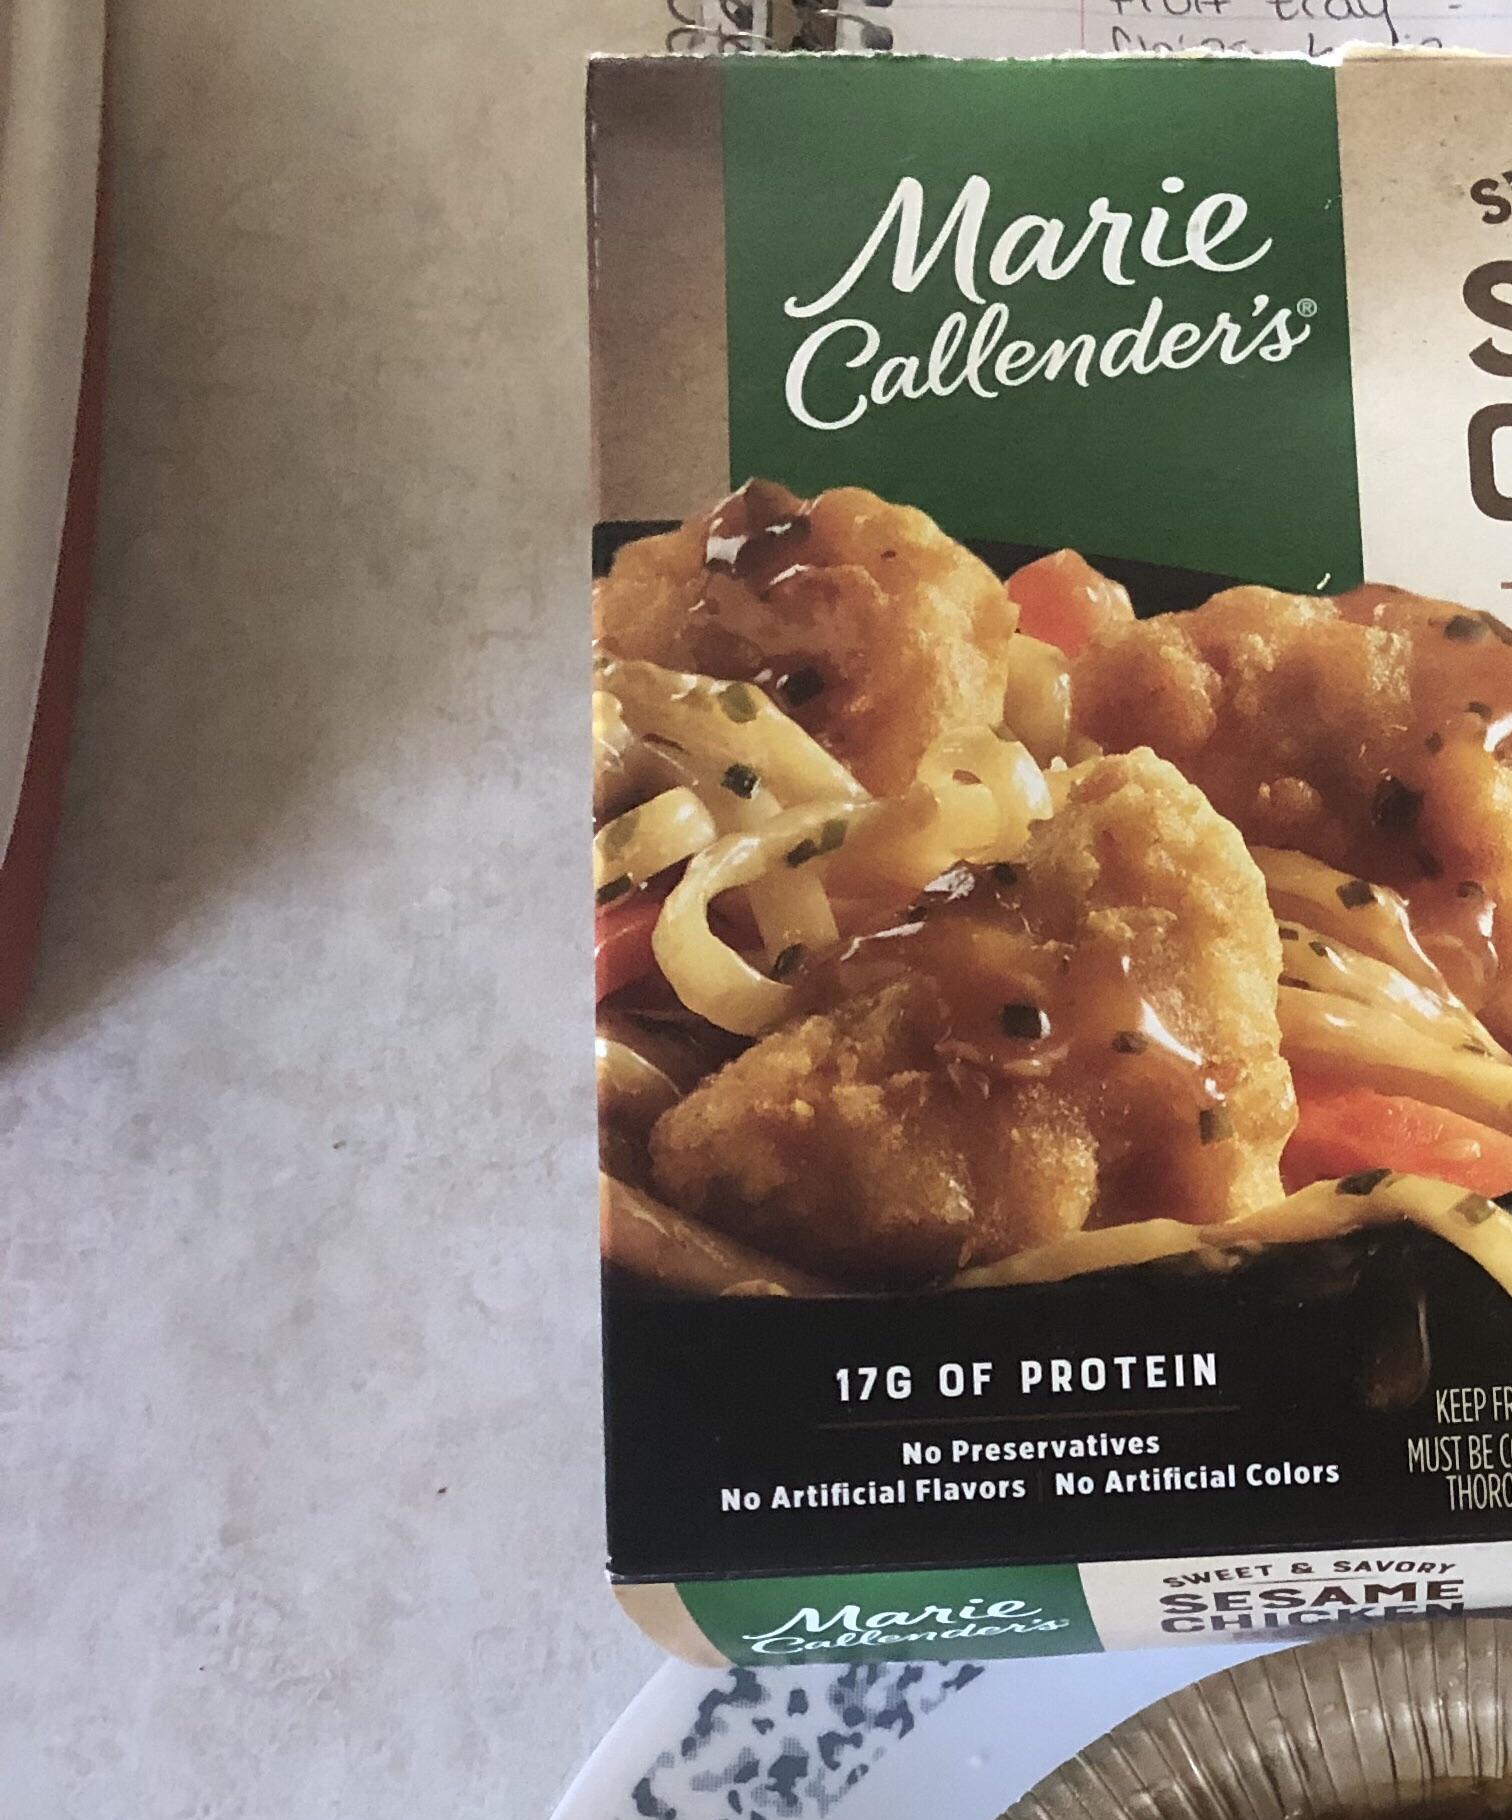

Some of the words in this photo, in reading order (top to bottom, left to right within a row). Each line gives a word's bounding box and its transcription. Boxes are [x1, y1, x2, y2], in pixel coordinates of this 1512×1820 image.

[1266, 0, 1400, 47] tray
[784, 174, 1273, 319] Marie
[836, 1365, 913, 1402] 17G
[938, 1361, 994, 1398] OF
[1020, 1352, 1220, 1394] PROTEIN
[1435, 1387, 1487, 1425] KEEP
[902, 1440, 941, 1466] No
[951, 1432, 1161, 1464] Preservatives
[1407, 1436, 1462, 1473] MUST
[1468, 1434, 1495, 1469] BE
[721, 1487, 760, 1512] No
[769, 1478, 906, 1510] Artificial
[915, 1473, 1027, 1504] Flavors
[1054, 1471, 1095, 1497] No
[1104, 1464, 1237, 1495] Artificial
[1245, 1459, 1341, 1488] Colors
[1162, 1564, 1273, 1588] SWEET
[1290, 1562, 1314, 1575] &
[1332, 1560, 1457, 1575] SAVORY
[1159, 1579, 1465, 1614] SESAME
[741, 1597, 1043, 1640] Marie
